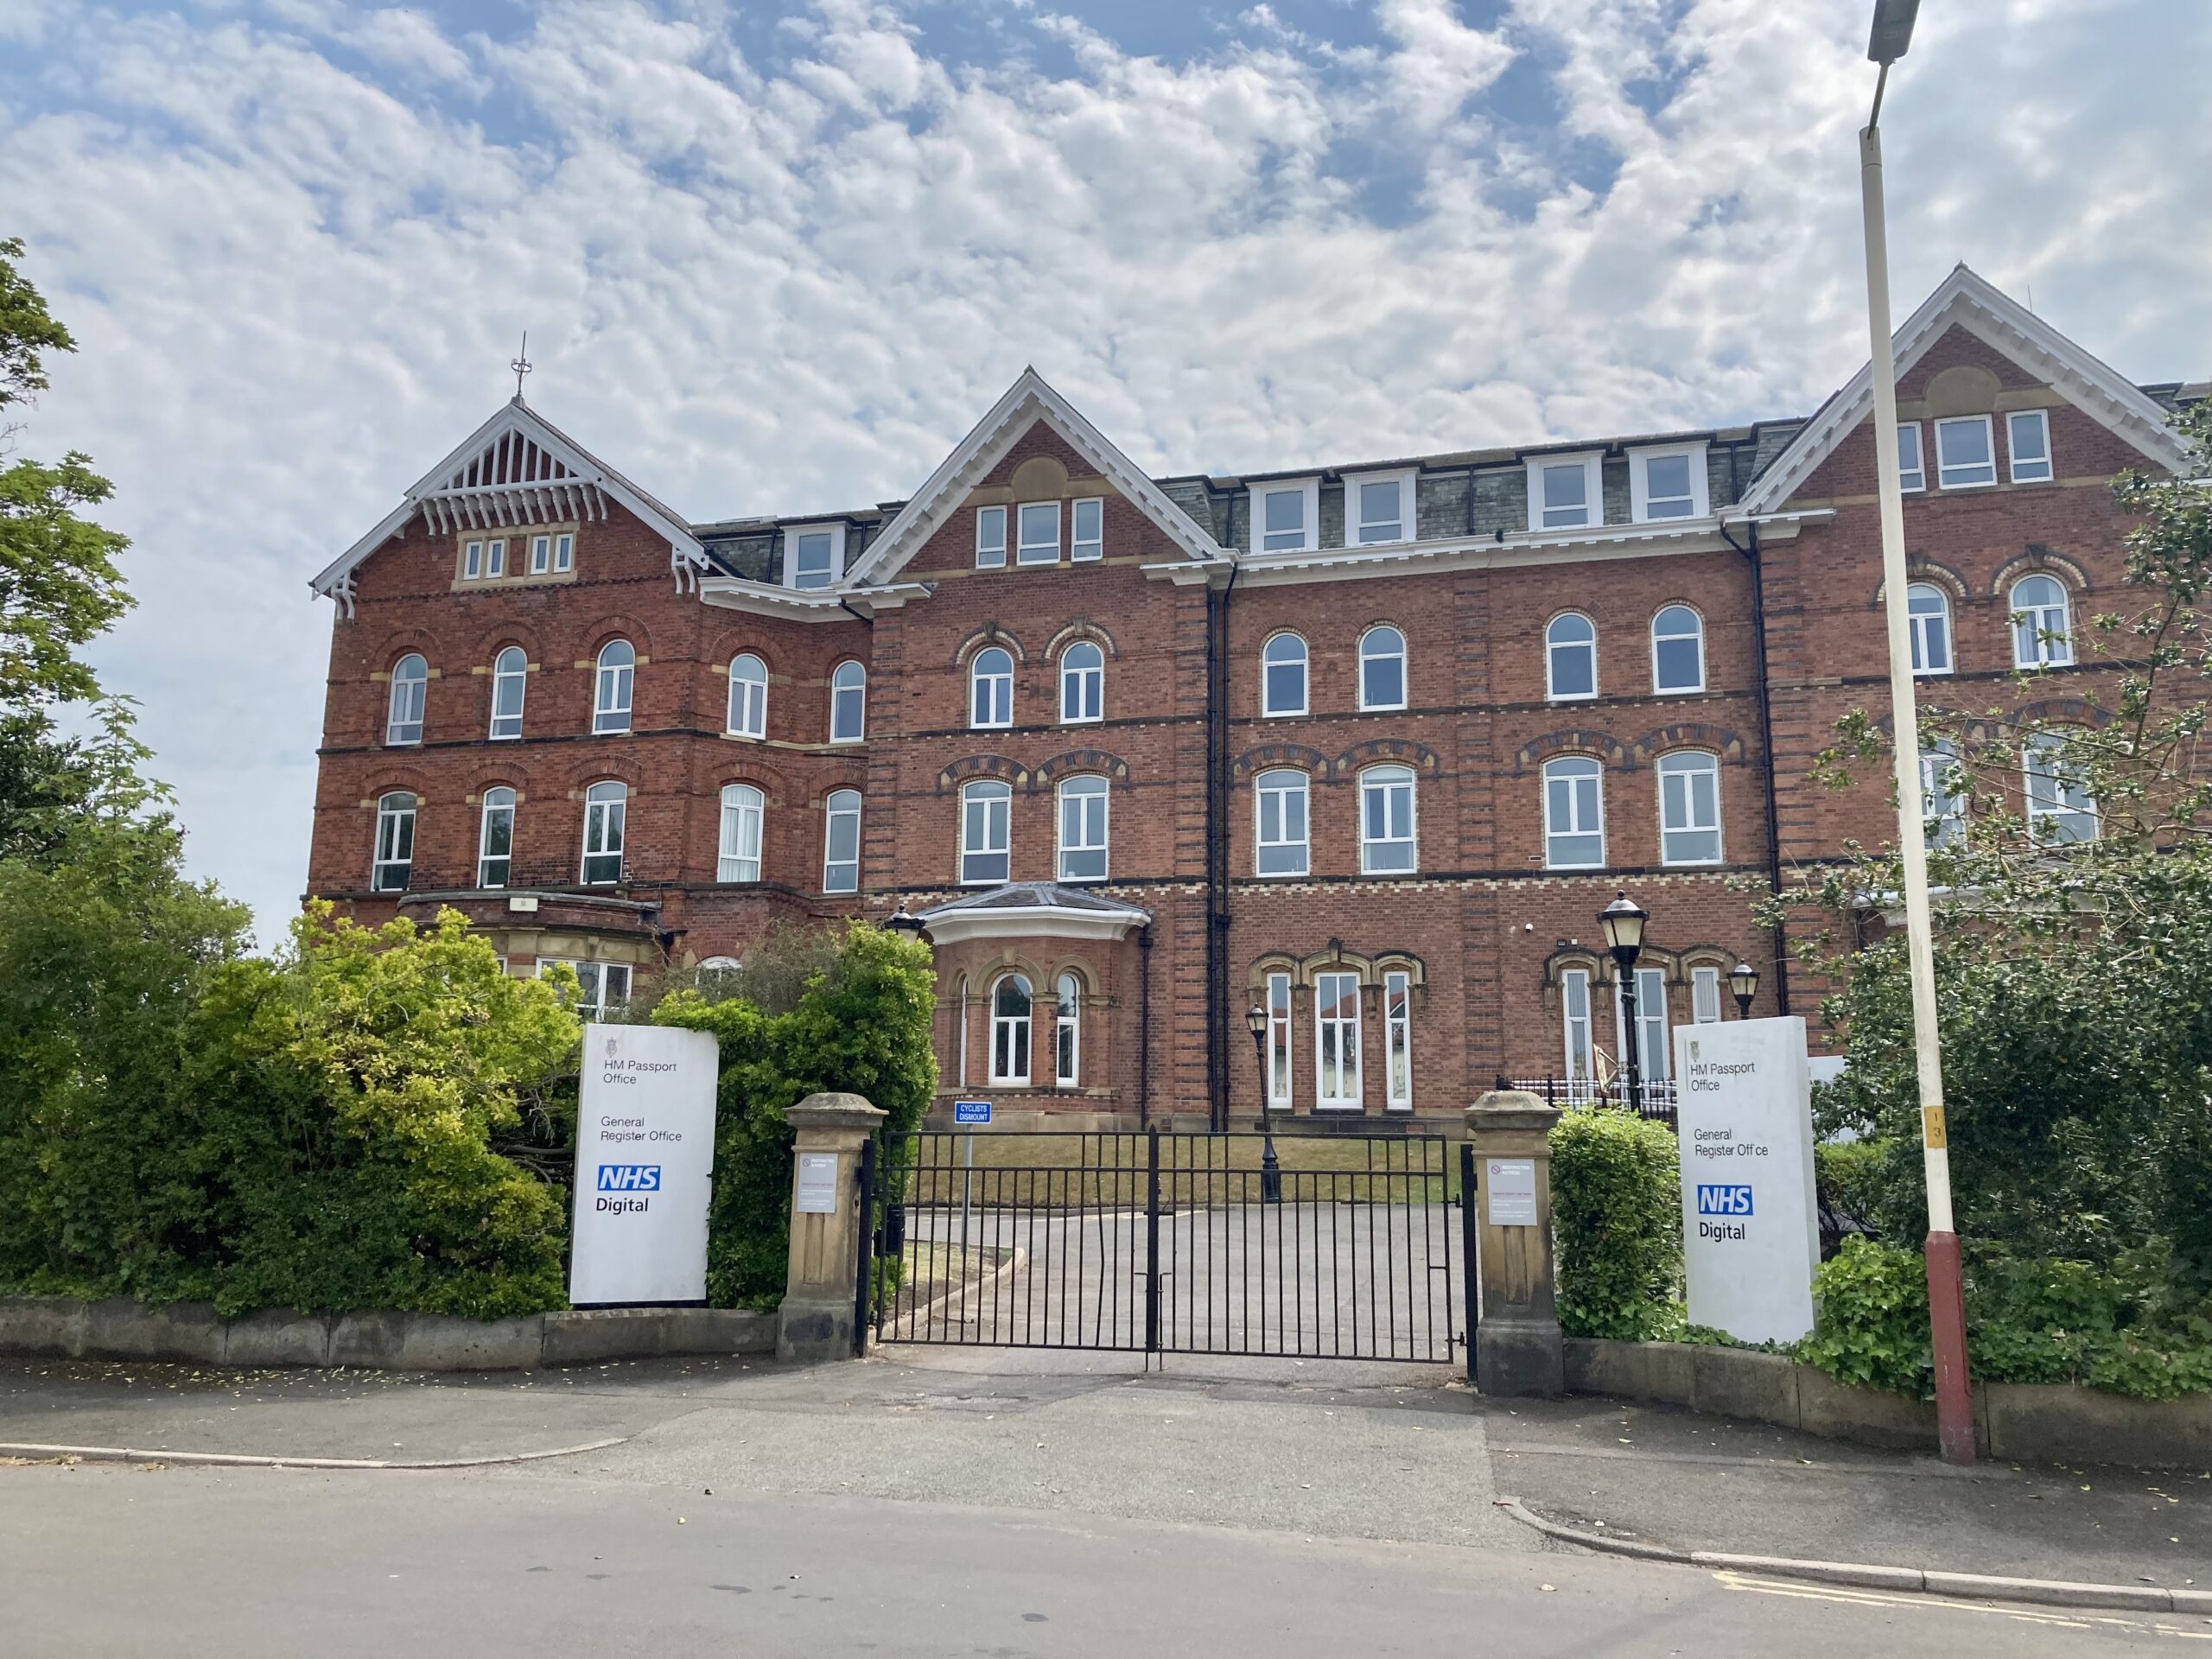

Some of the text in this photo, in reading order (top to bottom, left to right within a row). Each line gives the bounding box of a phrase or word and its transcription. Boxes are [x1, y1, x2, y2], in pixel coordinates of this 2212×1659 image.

[604, 1059, 677, 1073] HM Passport
[1690, 1061, 1755, 1077] HM Passport
[603, 1073, 637, 1084] Office
[1691, 1079, 1720, 1091] Office
[601, 1116, 645, 1127] General
[601, 1130, 683, 1143] Register Office
[1694, 1128, 1732, 1141] General
[1695, 1143, 1769, 1160] Register Offce
[599, 1166, 659, 1190] NHS
[596, 1198, 649, 1215] Digital
[1700, 1186, 1751, 1214] NHS
[1699, 1221, 1745, 1243] Digital
